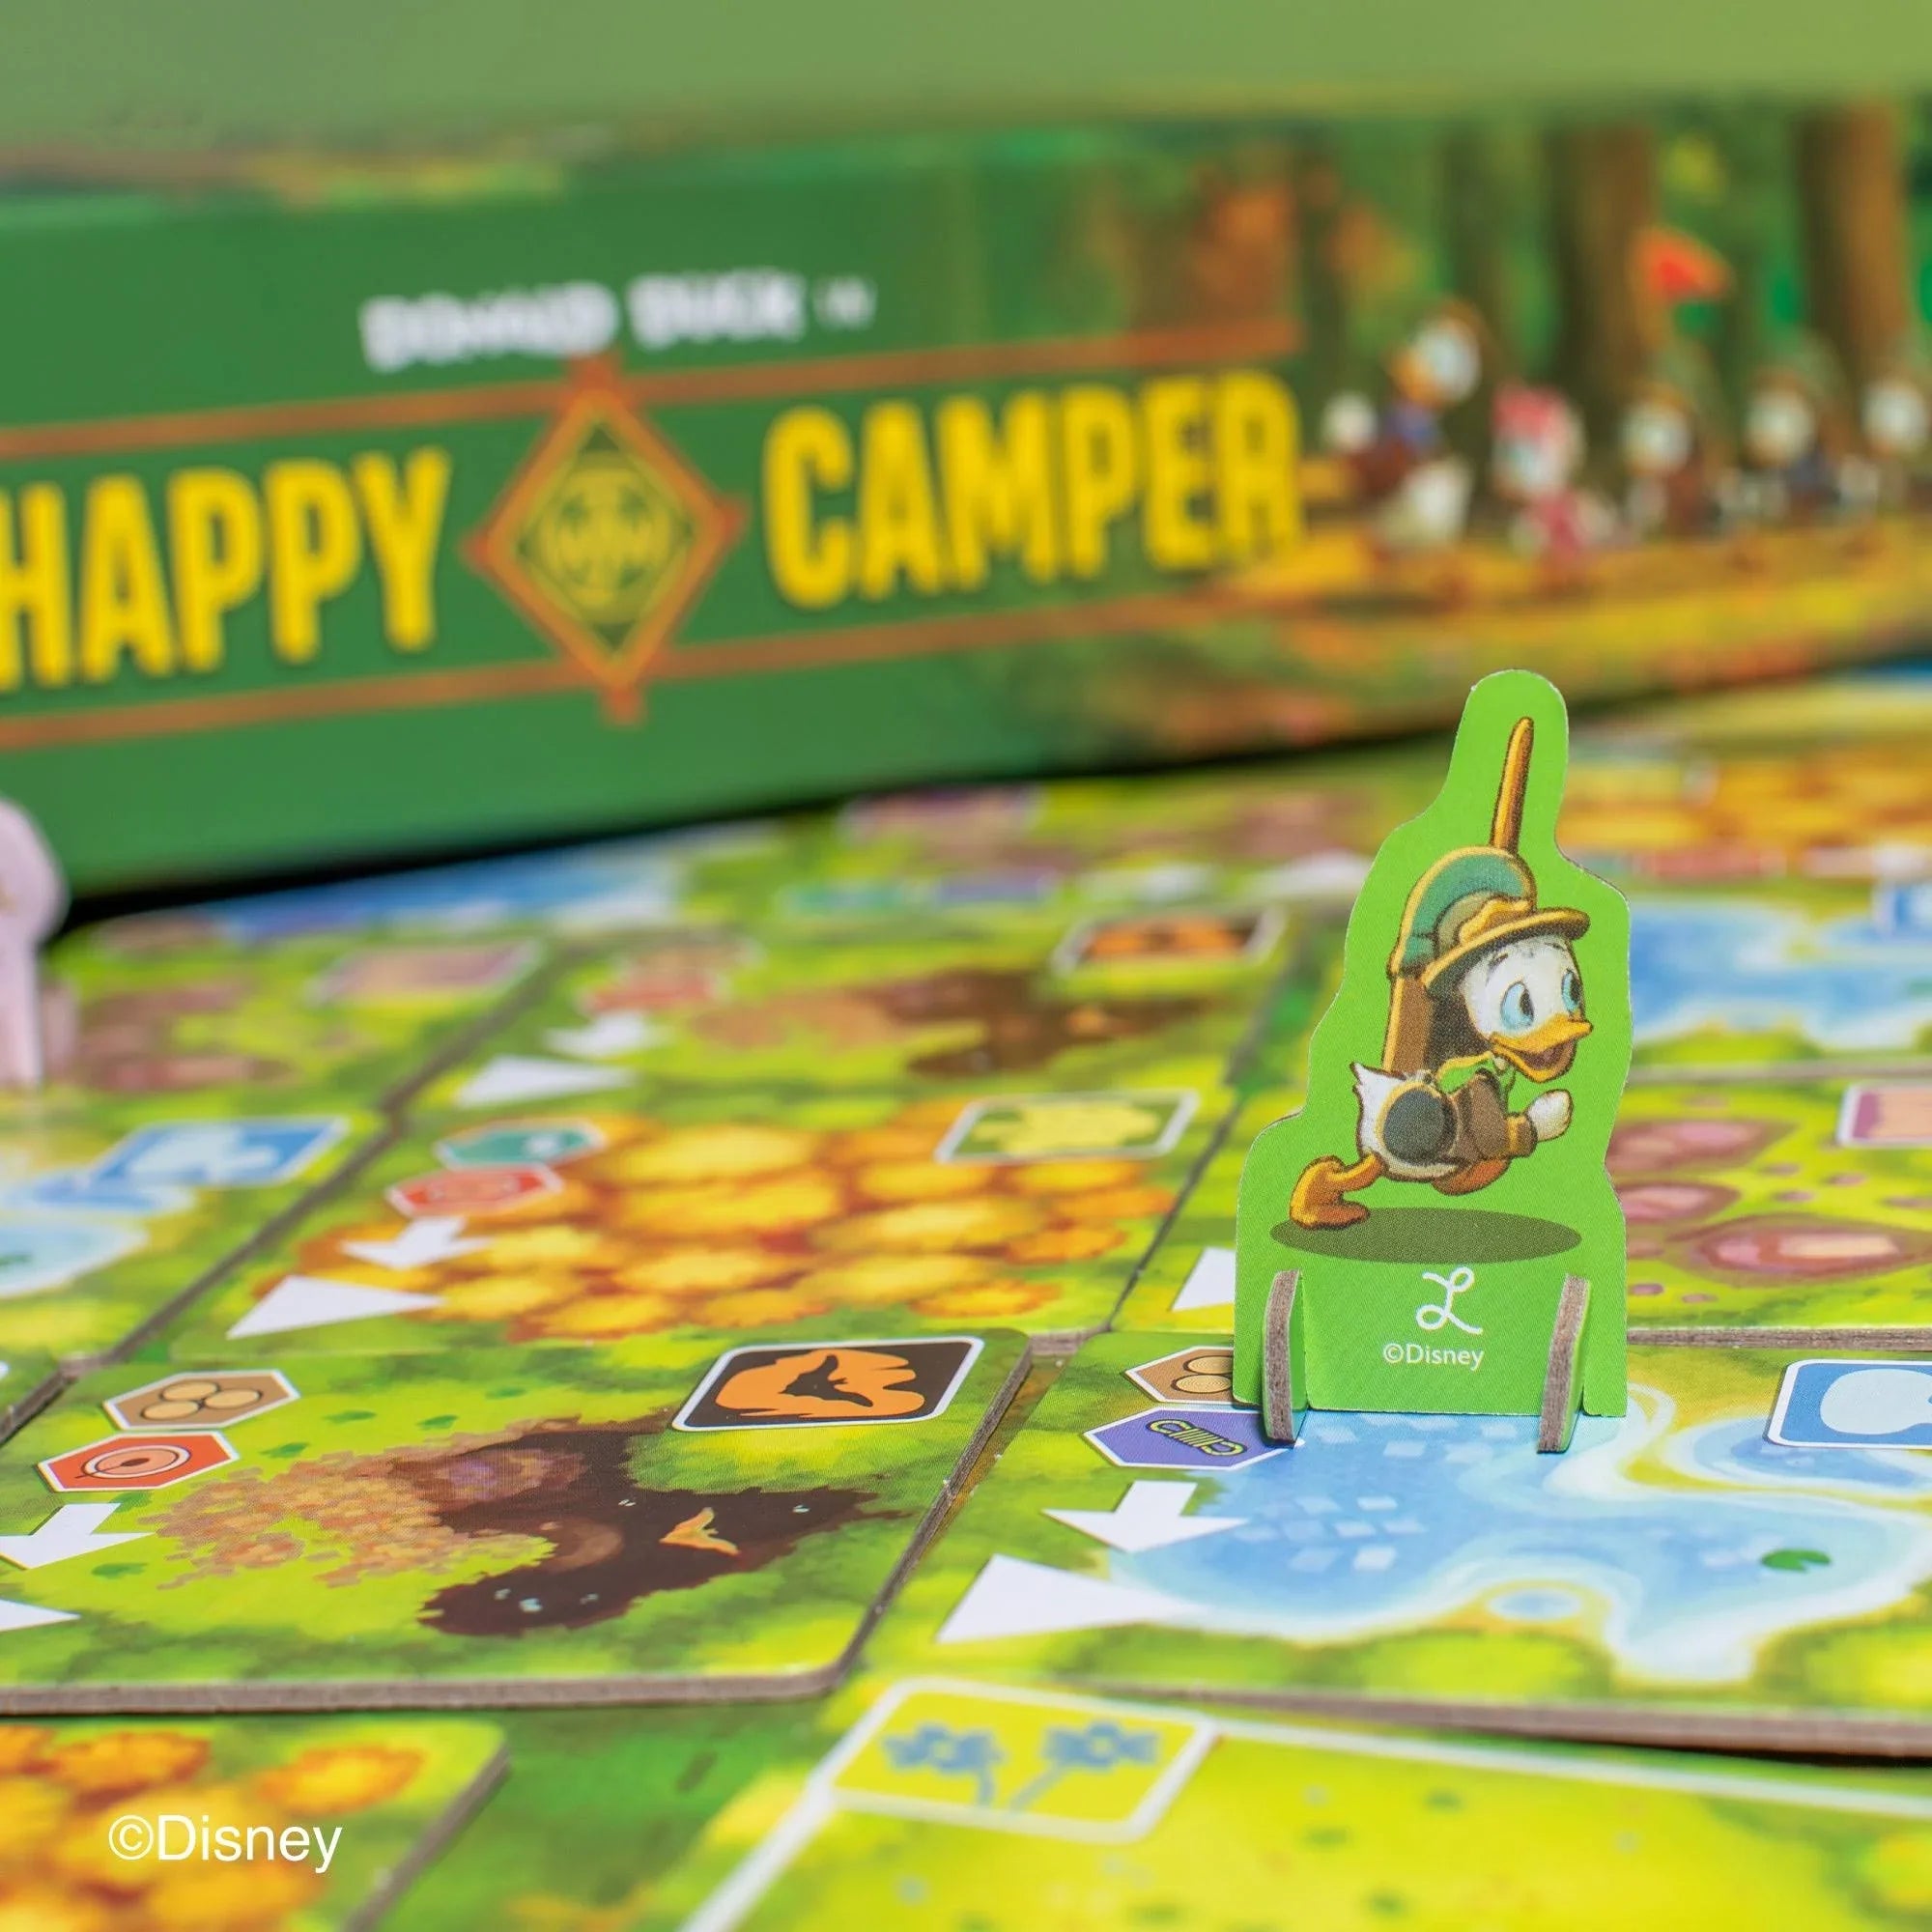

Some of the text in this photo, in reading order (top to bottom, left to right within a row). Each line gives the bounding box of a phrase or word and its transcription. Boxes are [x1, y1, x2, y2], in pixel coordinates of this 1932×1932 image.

[0, 369, 1304, 693] HAPPY CAMPER
[1382, 1343, 1486, 1372] ©Disney
